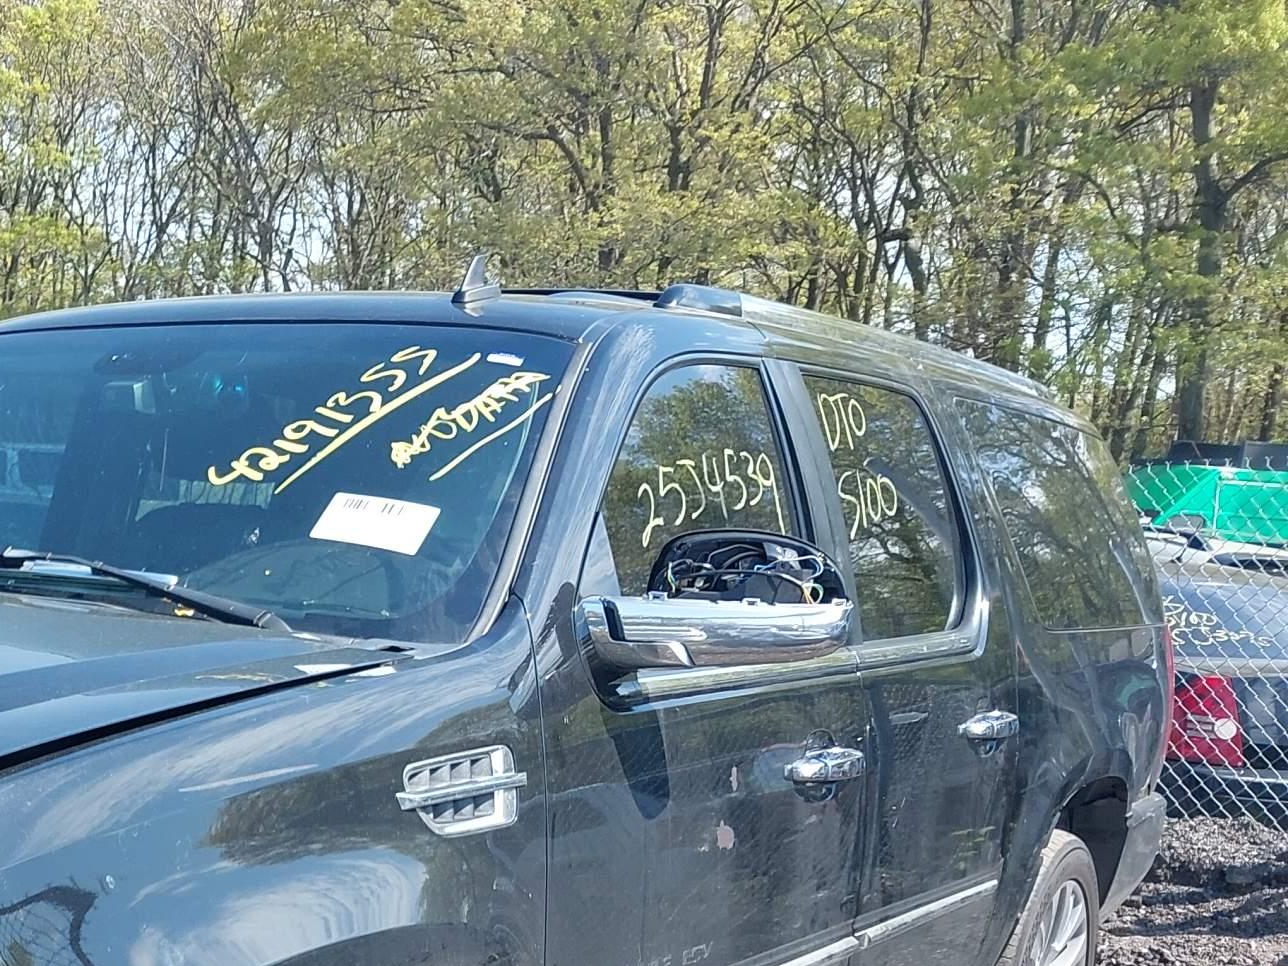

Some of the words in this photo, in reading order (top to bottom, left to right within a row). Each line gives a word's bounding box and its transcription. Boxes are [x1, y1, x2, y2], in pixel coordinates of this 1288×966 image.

[208, 345, 438, 486] 42191355
[816, 392, 867, 453] DTO
[636, 448, 787, 548] 25J4539
[837, 471, 899, 540] S100
